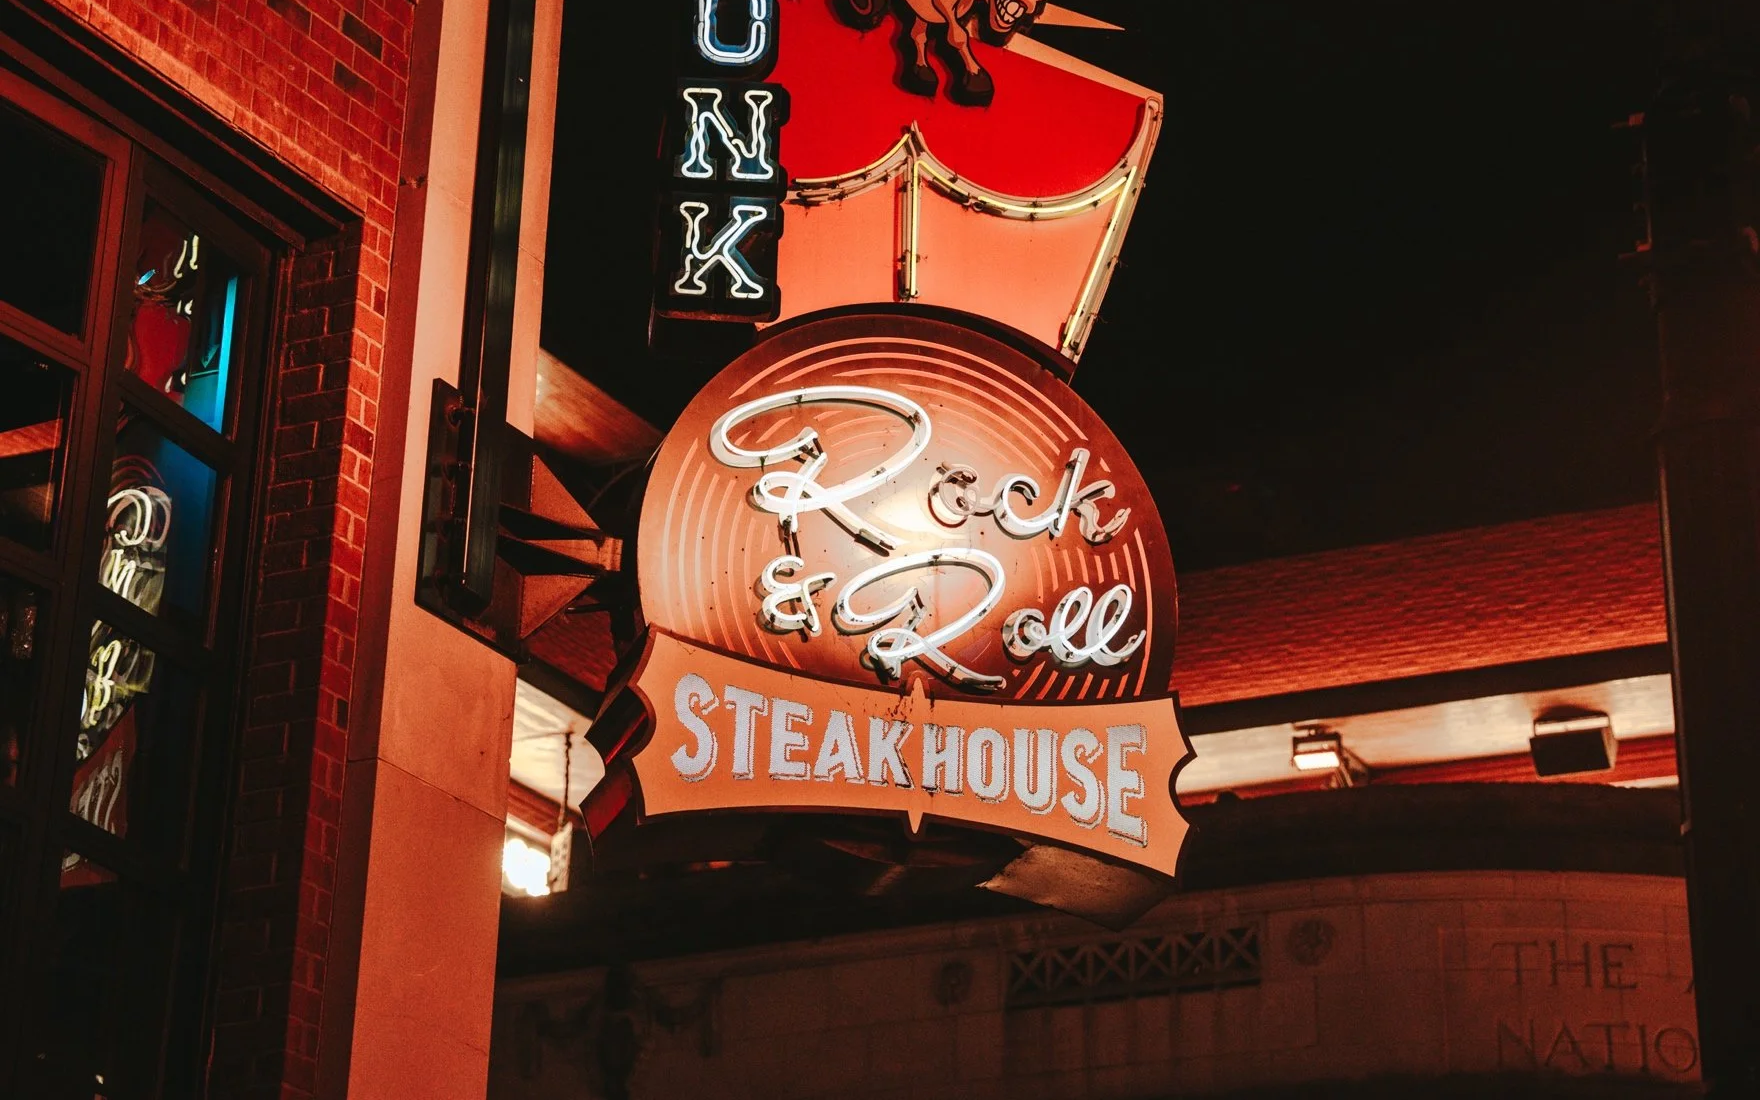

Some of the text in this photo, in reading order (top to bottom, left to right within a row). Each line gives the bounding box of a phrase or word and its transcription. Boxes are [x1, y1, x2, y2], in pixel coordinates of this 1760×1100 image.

[710, 385, 1132, 555] Rock
[760, 547, 1147, 690] & Roll
[671, 673, 1148, 848] STEAKHOUSE
[1492, 939, 1638, 990] THE
